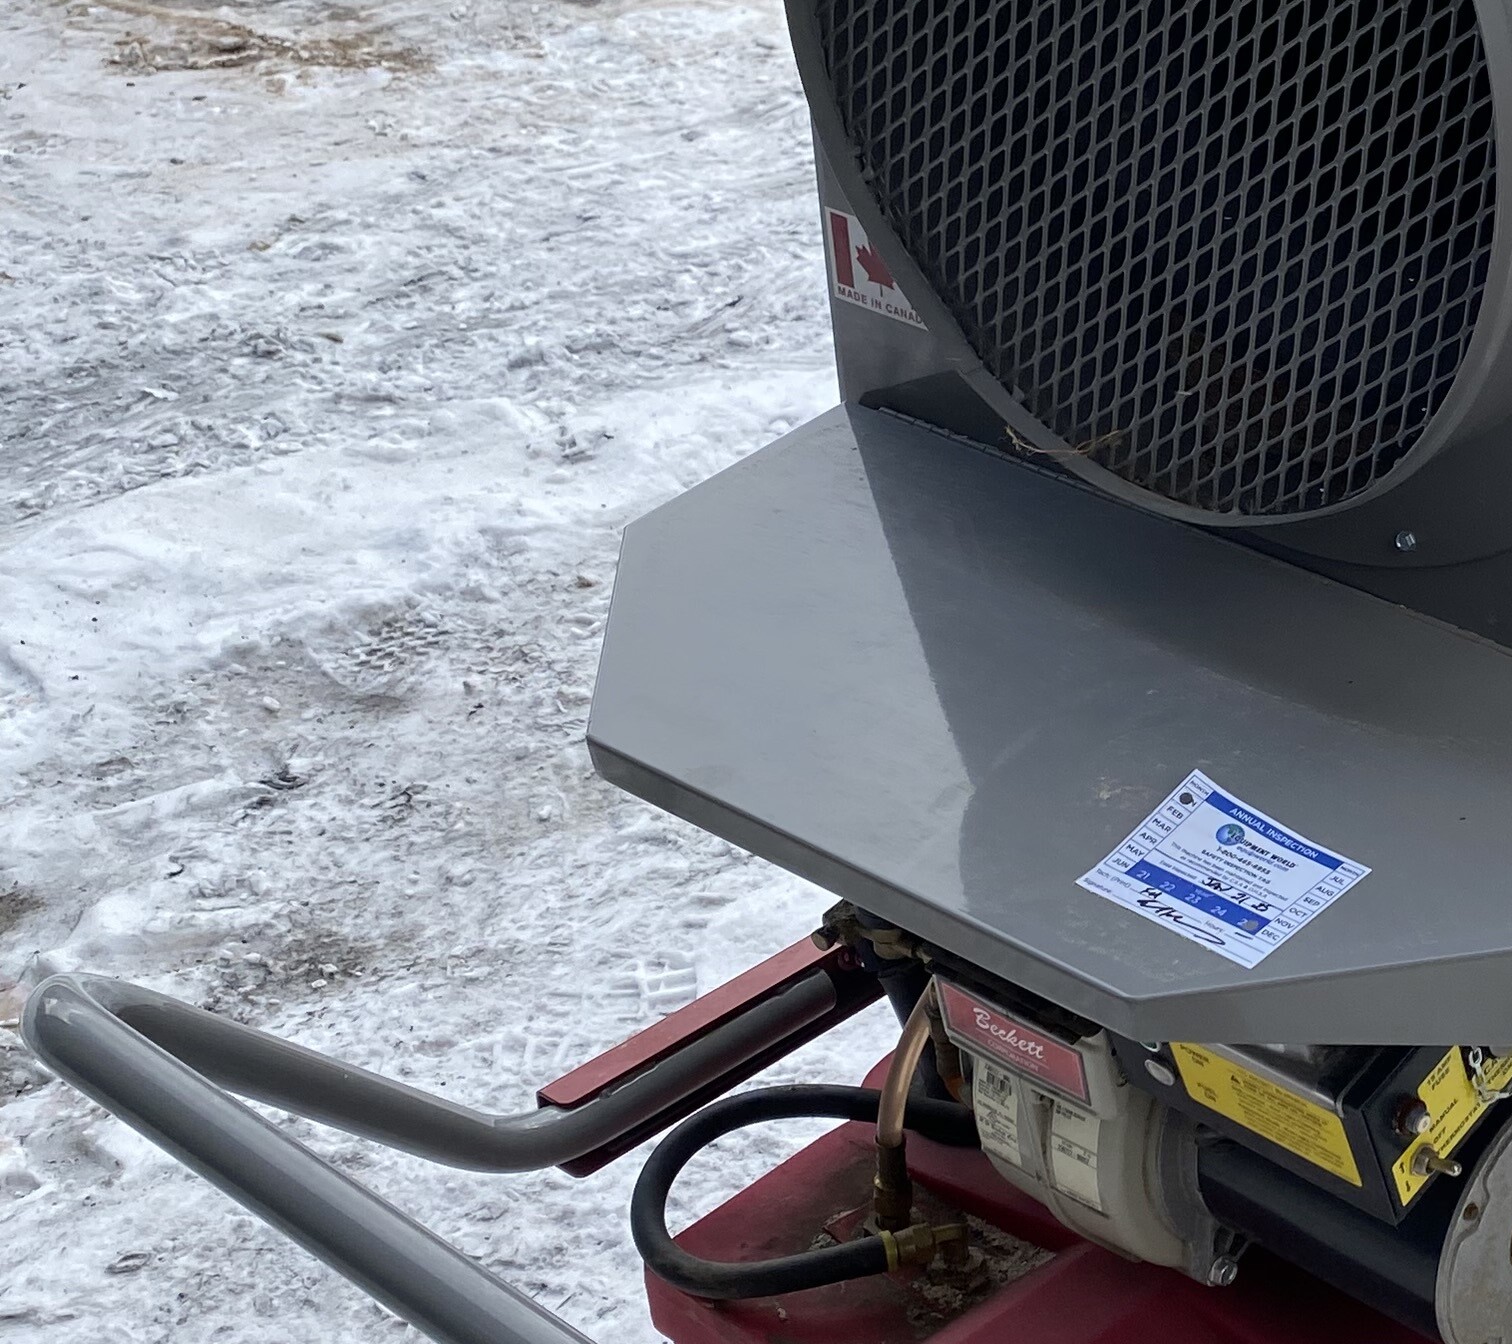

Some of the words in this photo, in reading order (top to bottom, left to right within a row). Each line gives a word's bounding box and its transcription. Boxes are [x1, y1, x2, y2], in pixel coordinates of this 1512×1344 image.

[838, 286, 868, 305] MADE
[871, 299, 883, 311] IN
[885, 304, 924, 325] CANAD
[1163, 805, 1186, 819] FEB
[1150, 817, 1173, 832] MAR
[1137, 830, 1159, 845] APR
[1227, 806, 1269, 832] ANNUAL
[1264, 826, 1319, 860] INSPECTION
[1123, 843, 1146, 857] MAY
[1110, 856, 1131, 869] JUN
[1269, 852, 1296, 869] WORLD
[1329, 874, 1347, 885] JUL
[1135, 869, 1152, 880] 21
[1158, 880, 1176, 892] 22
[1183, 892, 1202, 905] 23
[1209, 904, 1228, 916] 24
[1314, 884, 1335, 897] AUG
[1301, 895, 1321, 907] SEP
[1287, 906, 1308, 919] OCT
[1273, 917, 1295, 930] NOV
[1260, 928, 1281, 941] DEC
[973, 1007, 1045, 1060] Beckett
[1429, 1098, 1459, 1133] MANUAL
[1432, 1127, 1447, 1145] OFF
